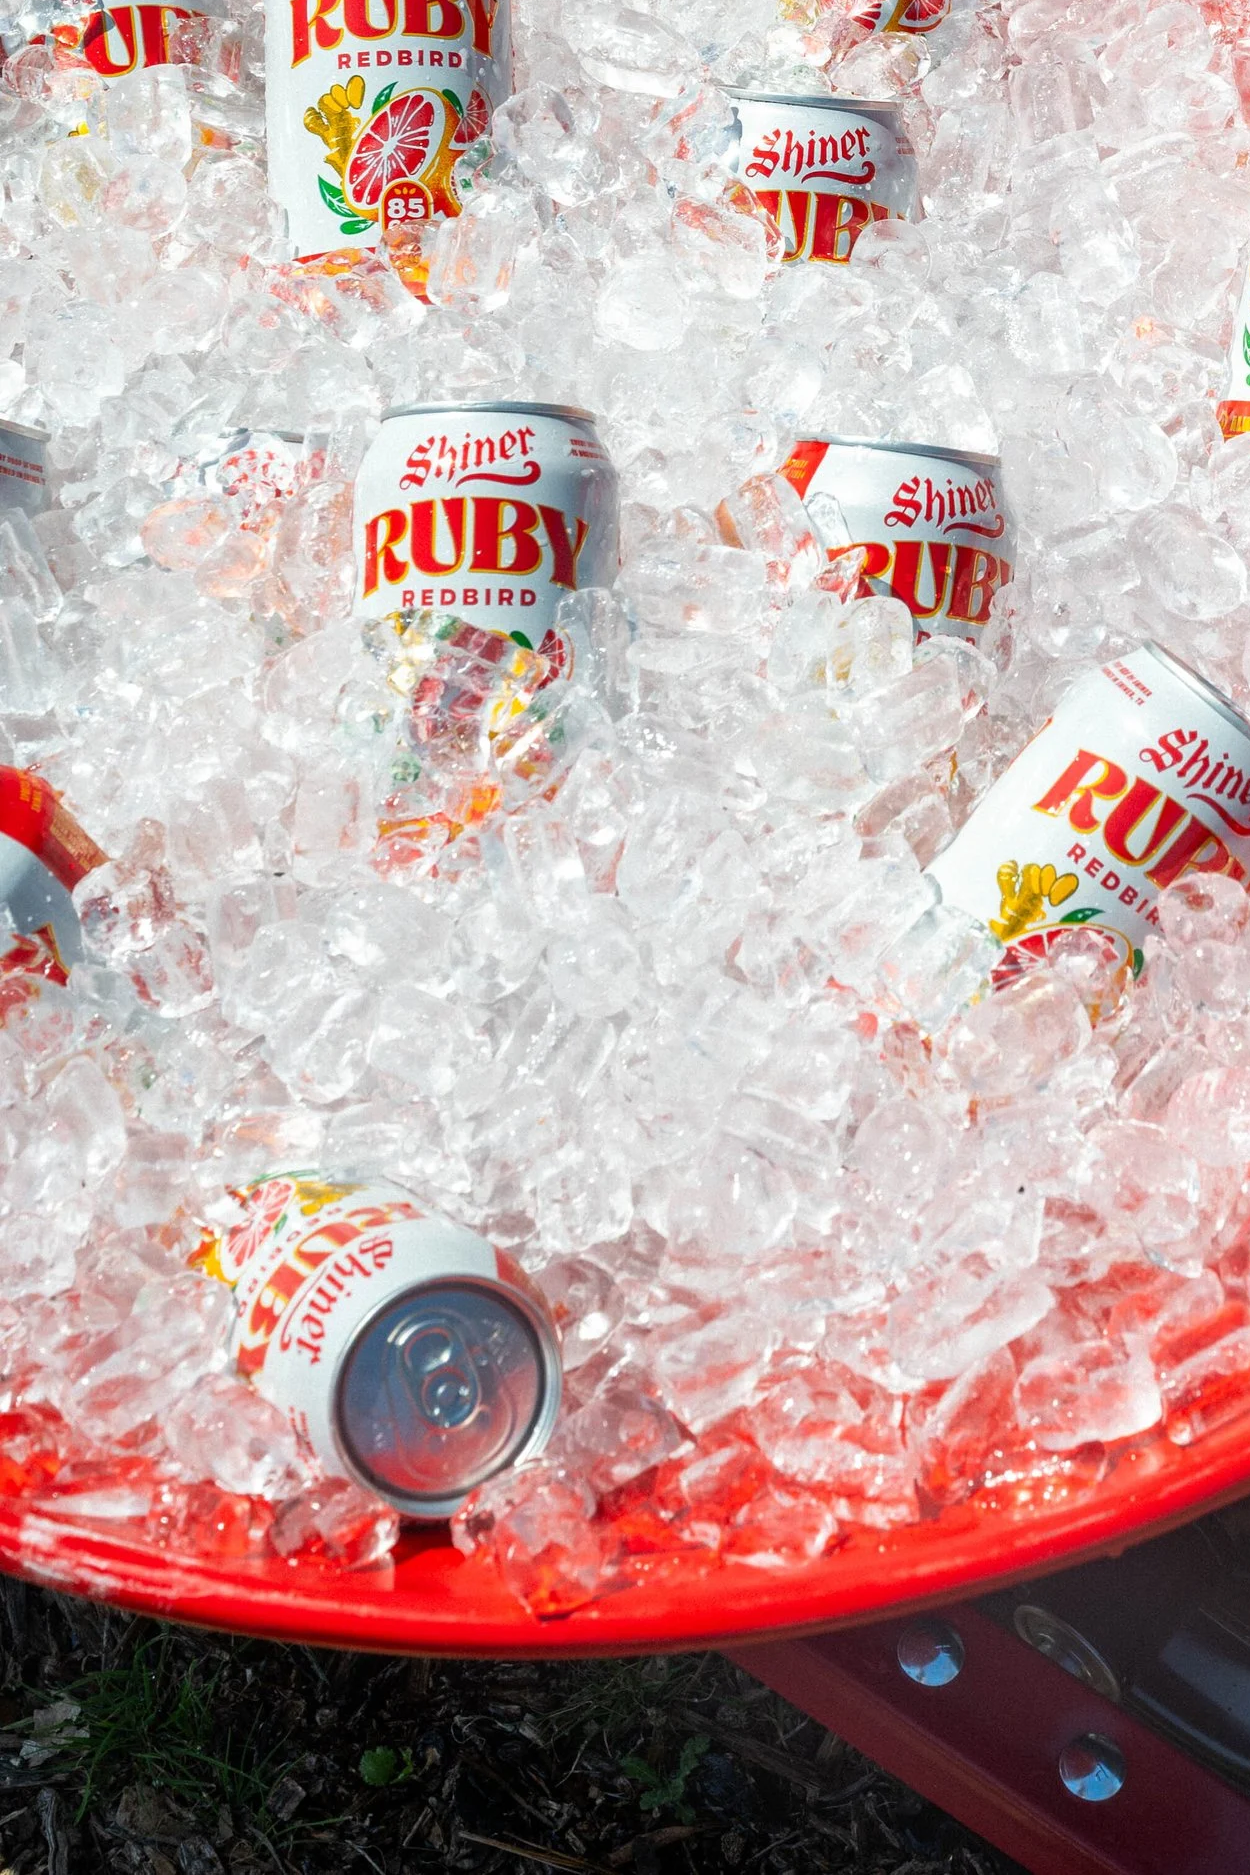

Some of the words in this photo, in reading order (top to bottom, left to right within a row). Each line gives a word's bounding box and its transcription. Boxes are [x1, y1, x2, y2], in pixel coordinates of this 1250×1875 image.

[337, 49, 463, 70] REDBIRD
[745, 125, 872, 179] Shiner
[386, 197, 426, 219] 85
[400, 426, 536, 491] Shiner
[884, 475, 997, 529] Shiner
[362, 496, 591, 600] RUBY
[402, 587, 538, 609] REDBIRD
[826, 539, 1015, 626] RUB
[1032, 748, 1247, 893] RUB
[1066, 842, 1161, 929] REDBIR
[296, 1231, 394, 1366] Shiner
